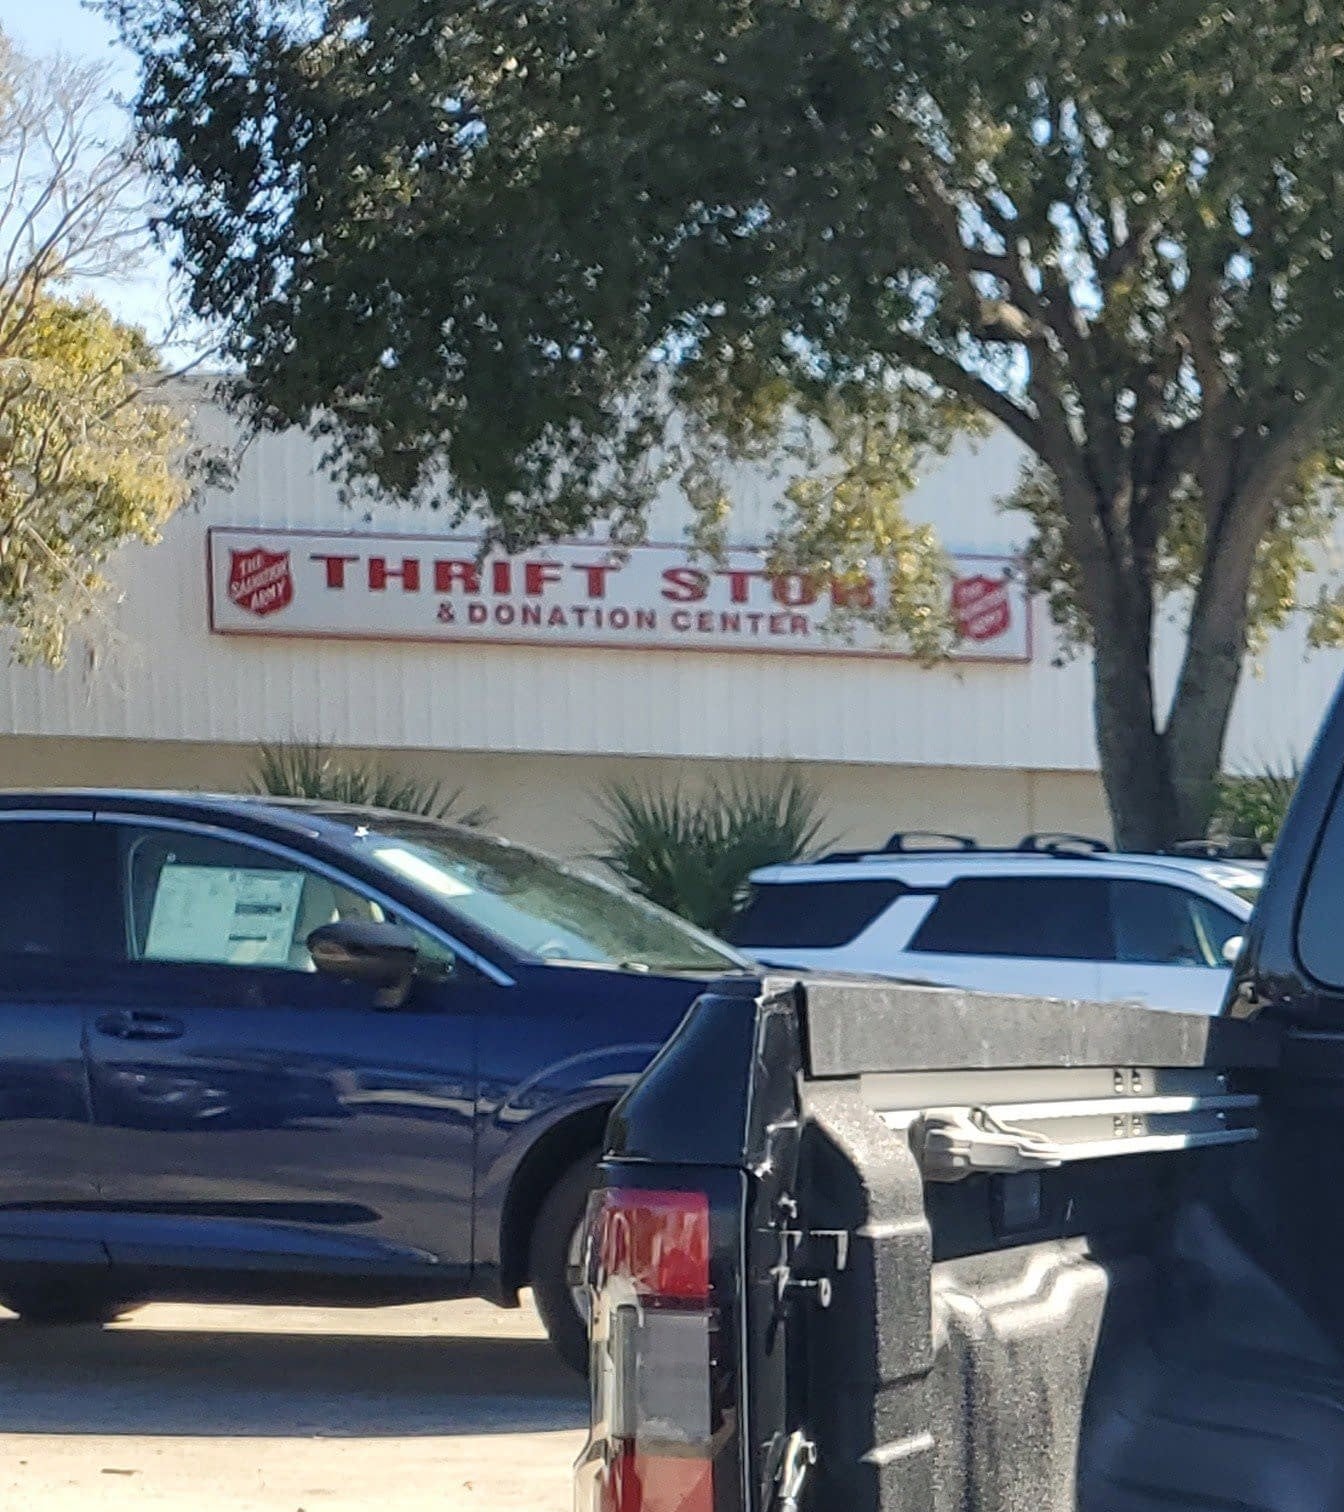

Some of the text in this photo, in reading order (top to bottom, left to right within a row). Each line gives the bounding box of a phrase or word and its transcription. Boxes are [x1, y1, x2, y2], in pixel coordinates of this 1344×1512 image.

[310, 553, 621, 599] THRIFT
[662, 568, 876, 608] STOR
[437, 602, 810, 636] & DONATION CENTER
